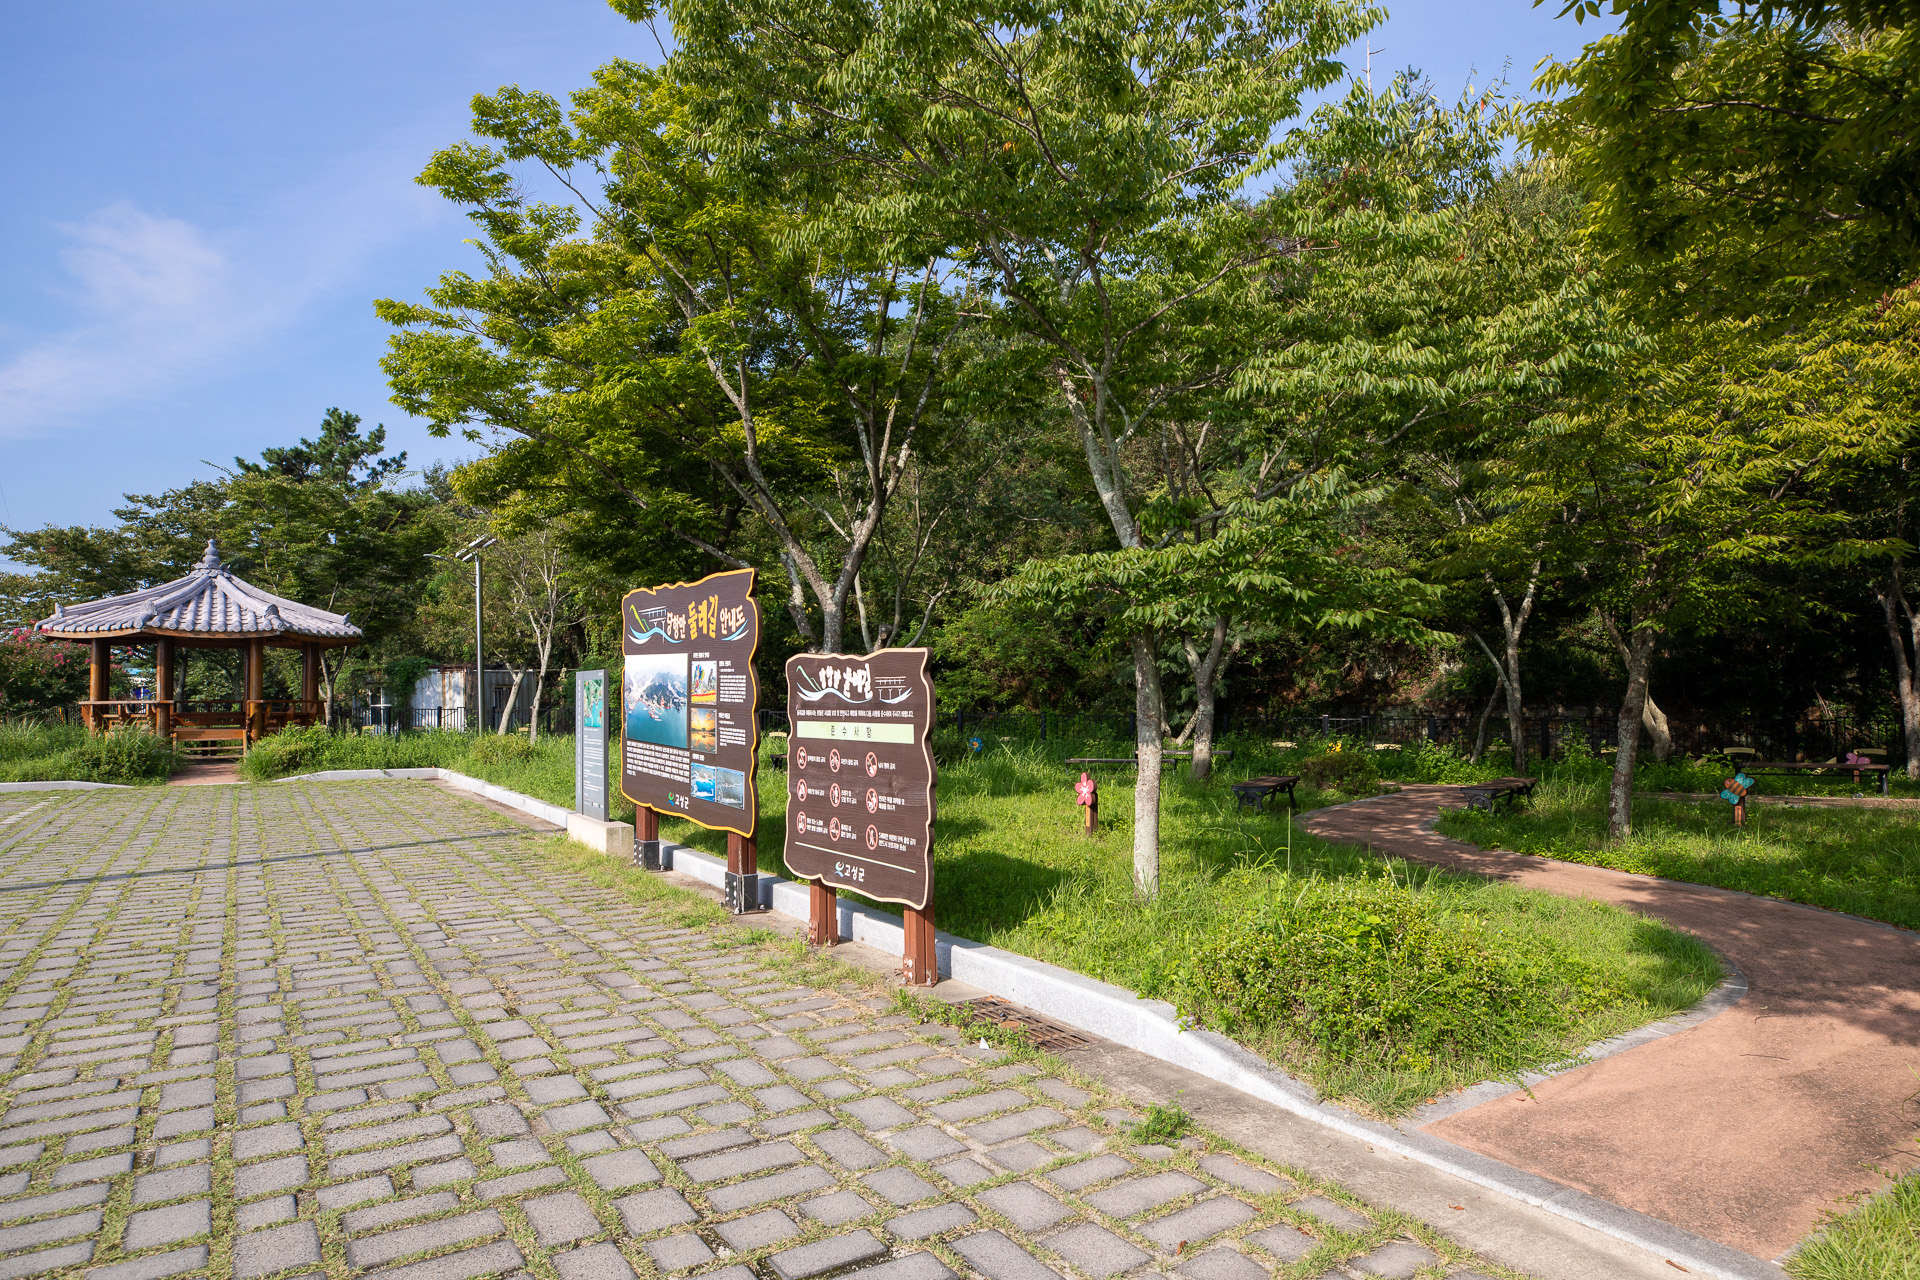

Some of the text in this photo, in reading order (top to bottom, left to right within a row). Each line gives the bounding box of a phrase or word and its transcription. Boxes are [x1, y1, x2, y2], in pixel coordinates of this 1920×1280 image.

[688, 594, 718, 640] 둘레길
[720, 605, 746, 635] 안내도
[831, 725, 872, 739] 준수사항
[675, 793, 689, 809] 고성군
[844, 864, 865, 882] 고성군
